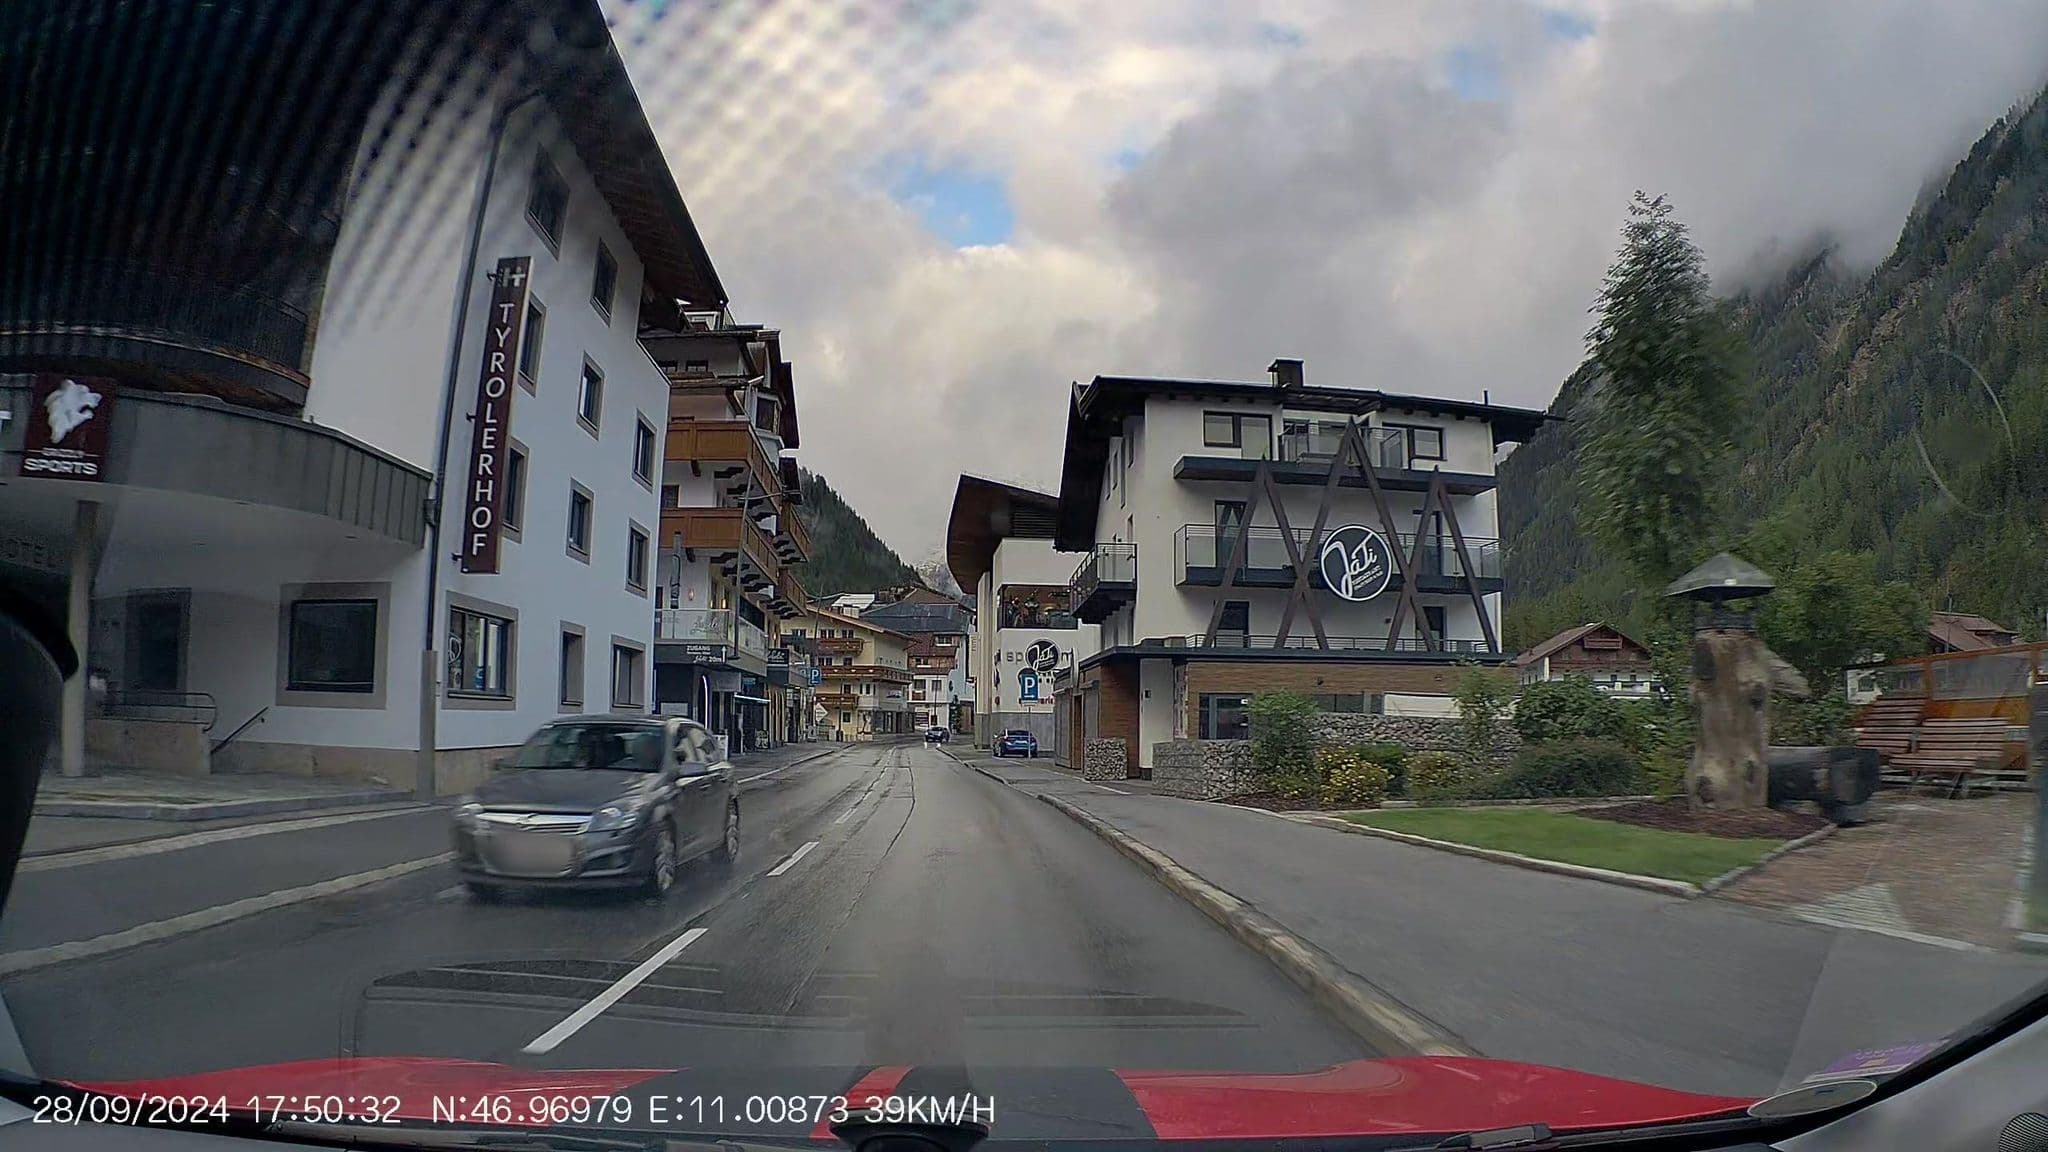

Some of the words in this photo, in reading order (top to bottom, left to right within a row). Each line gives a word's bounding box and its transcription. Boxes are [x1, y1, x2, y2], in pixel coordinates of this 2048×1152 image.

[472, 303, 514, 556] TYROLERHOF
[24, 457, 98, 476] SPORTS
[812, 669, 820, 682] P
[1024, 677, 1036, 694] P
